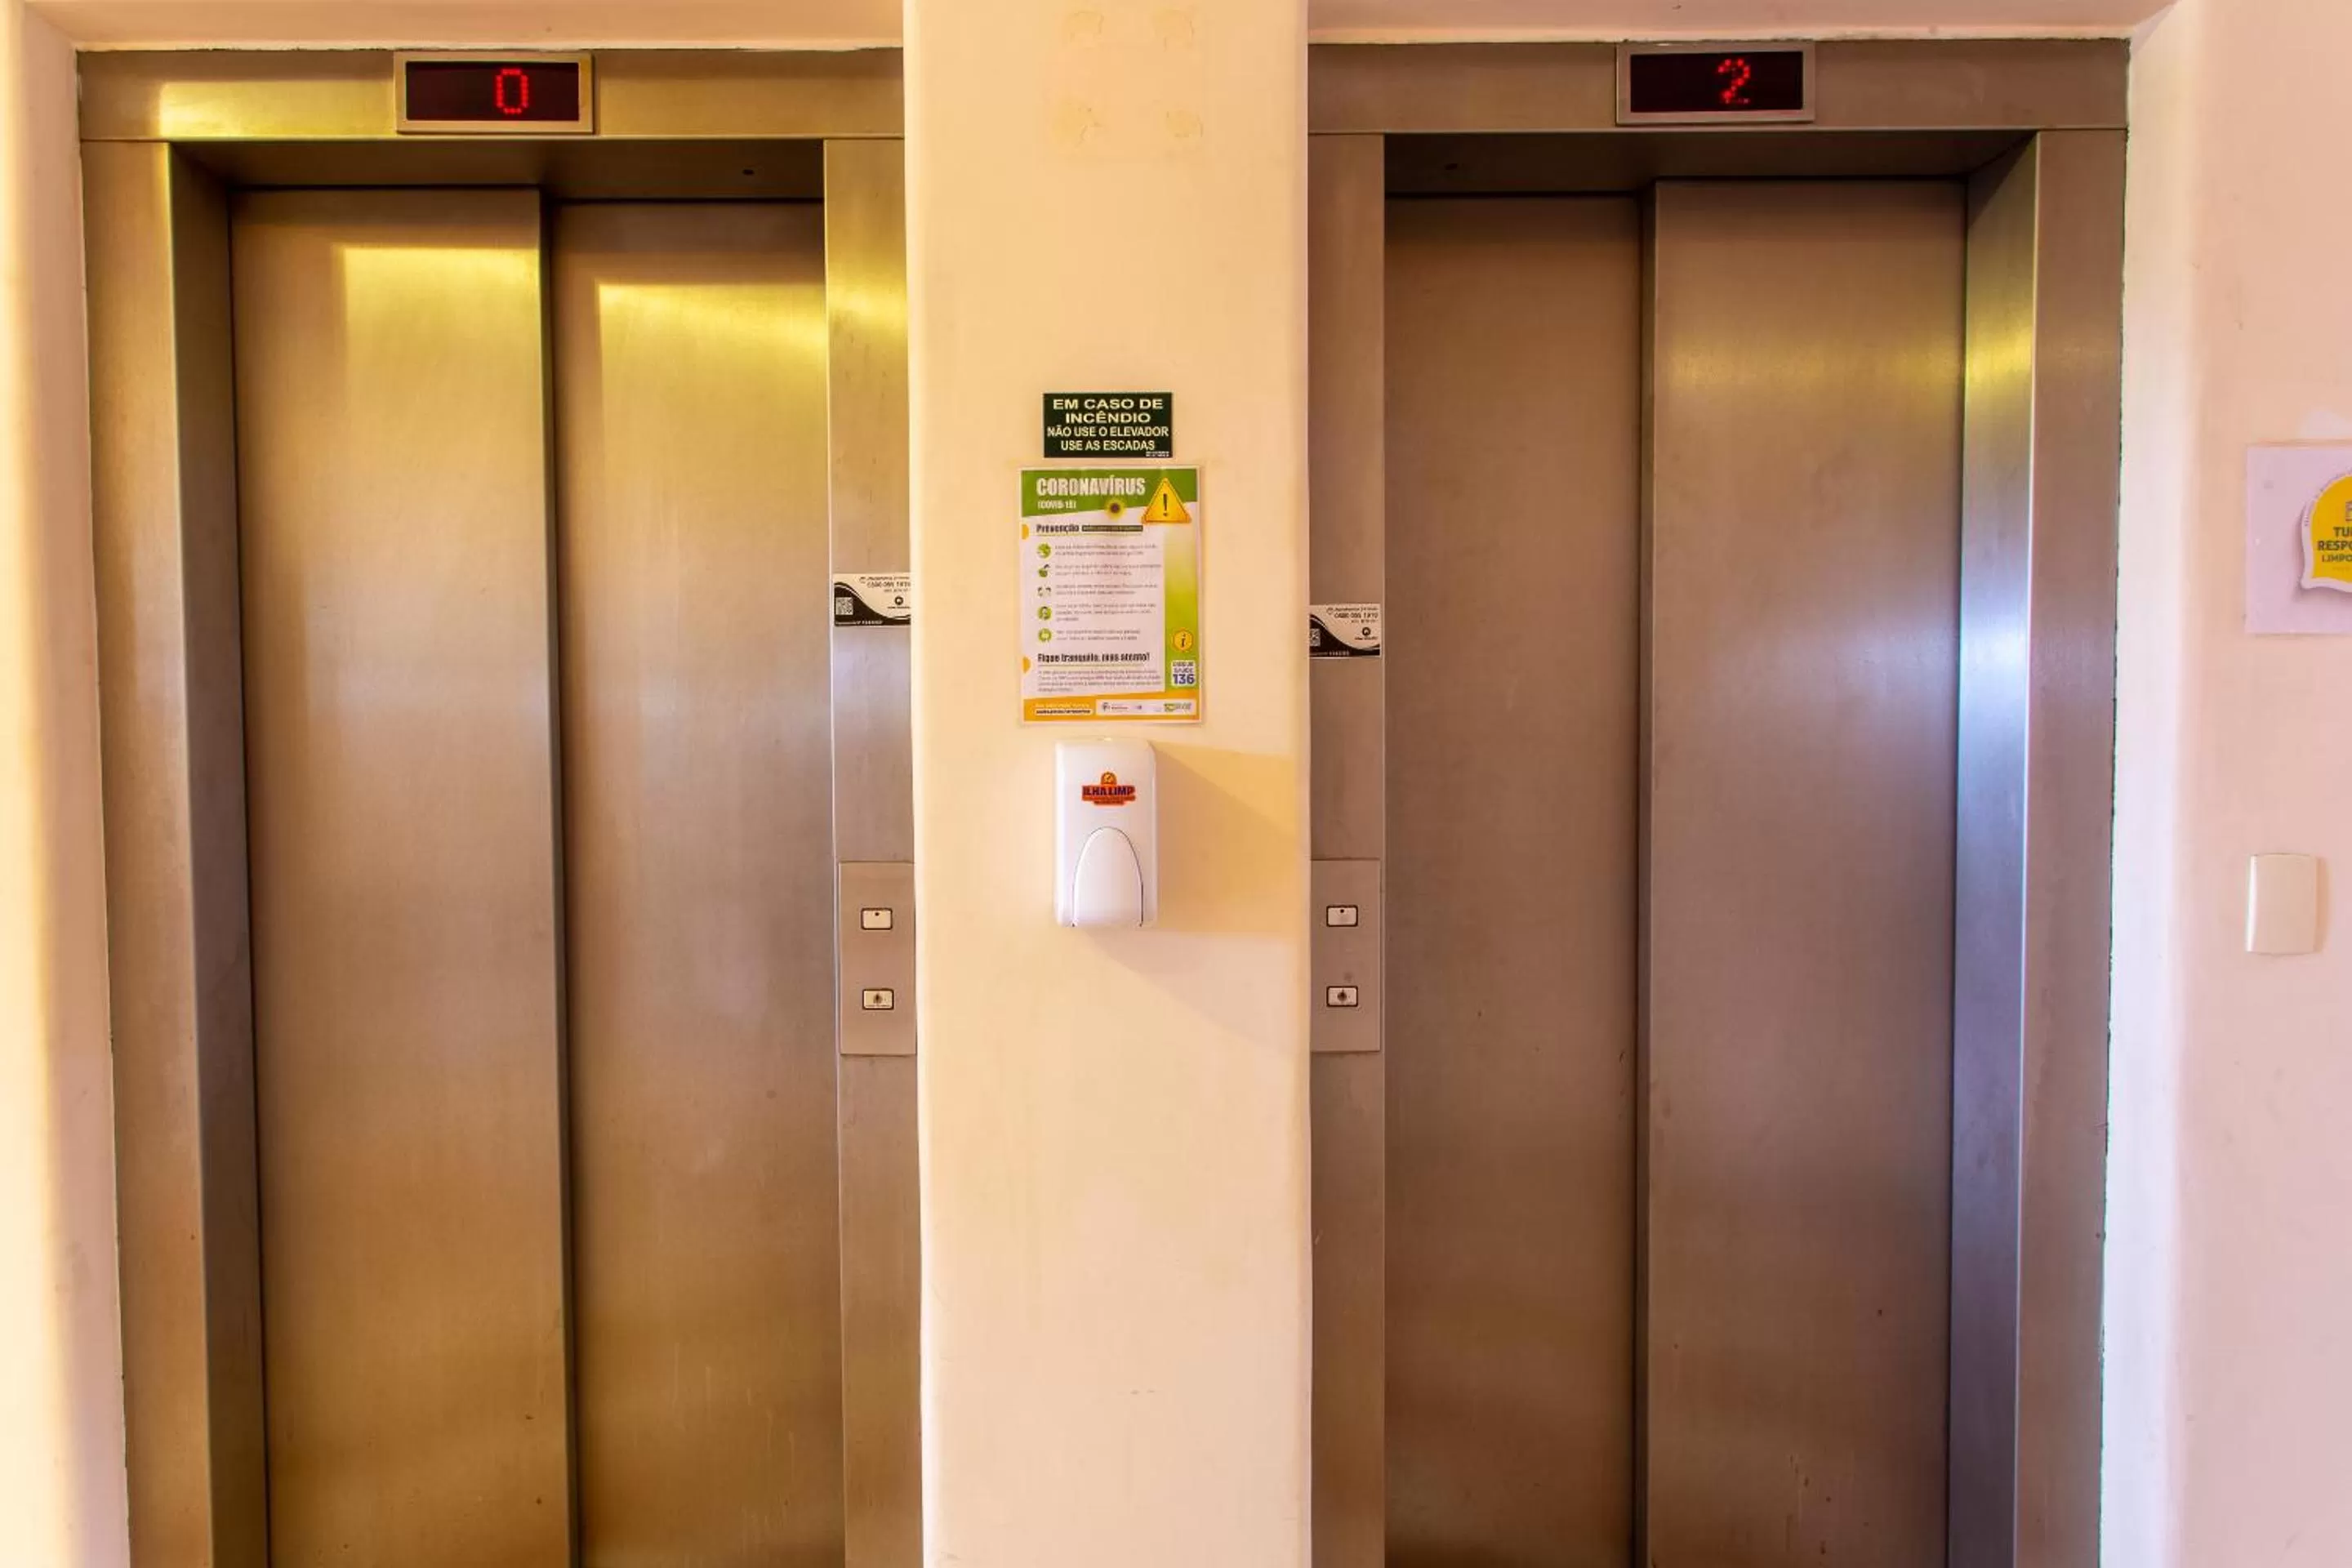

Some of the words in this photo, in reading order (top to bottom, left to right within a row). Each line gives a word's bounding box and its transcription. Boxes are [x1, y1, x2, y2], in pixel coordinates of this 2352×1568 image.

[1717, 58, 1750, 104] 2
[496, 68, 528, 114] 0
[1054, 399, 1078, 409] EM
[1084, 399, 1134, 409] CASO
[1139, 399, 1163, 409] DE
[1066, 411, 1152, 423] INCÊNDIO
[1047, 425, 1071, 437] NÃO
[1074, 426, 1096, 437] USE
[1098, 426, 1108, 437] O
[1110, 426, 1169, 437] ELEVADOR
[1062, 440, 1083, 451] USE
[1085, 440, 1101, 451] AS
[1103, 440, 1156, 451] ESCADAS
[1036, 475, 1146, 496] CORONAVÍRUS
[1173, 674, 1195, 684] 136
